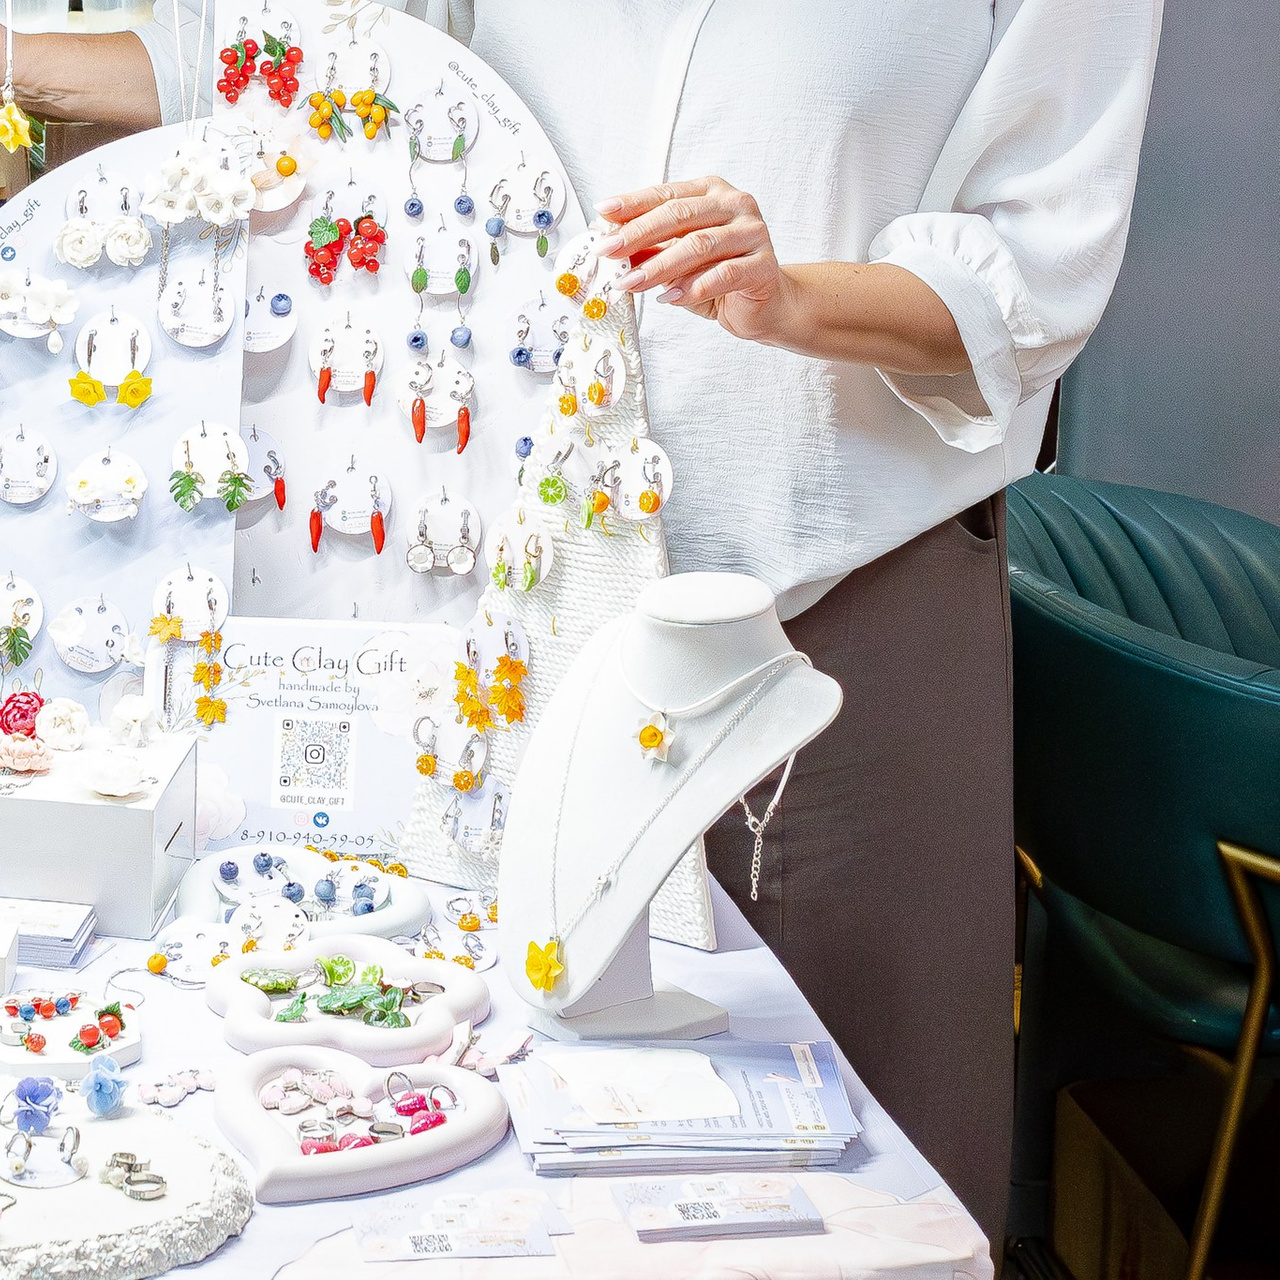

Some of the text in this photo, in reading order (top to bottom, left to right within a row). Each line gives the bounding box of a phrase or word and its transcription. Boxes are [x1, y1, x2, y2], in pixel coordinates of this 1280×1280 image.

[447, 60, 522, 137] @cute_clay_gift
[223, 642, 407, 679] Cute Clay Gift
[278, 677, 361, 698] handmade by
[246, 692, 380, 715] Svetlana Samoylova
[279, 794, 345, 807] @CUTE_CLAY_GIFT
